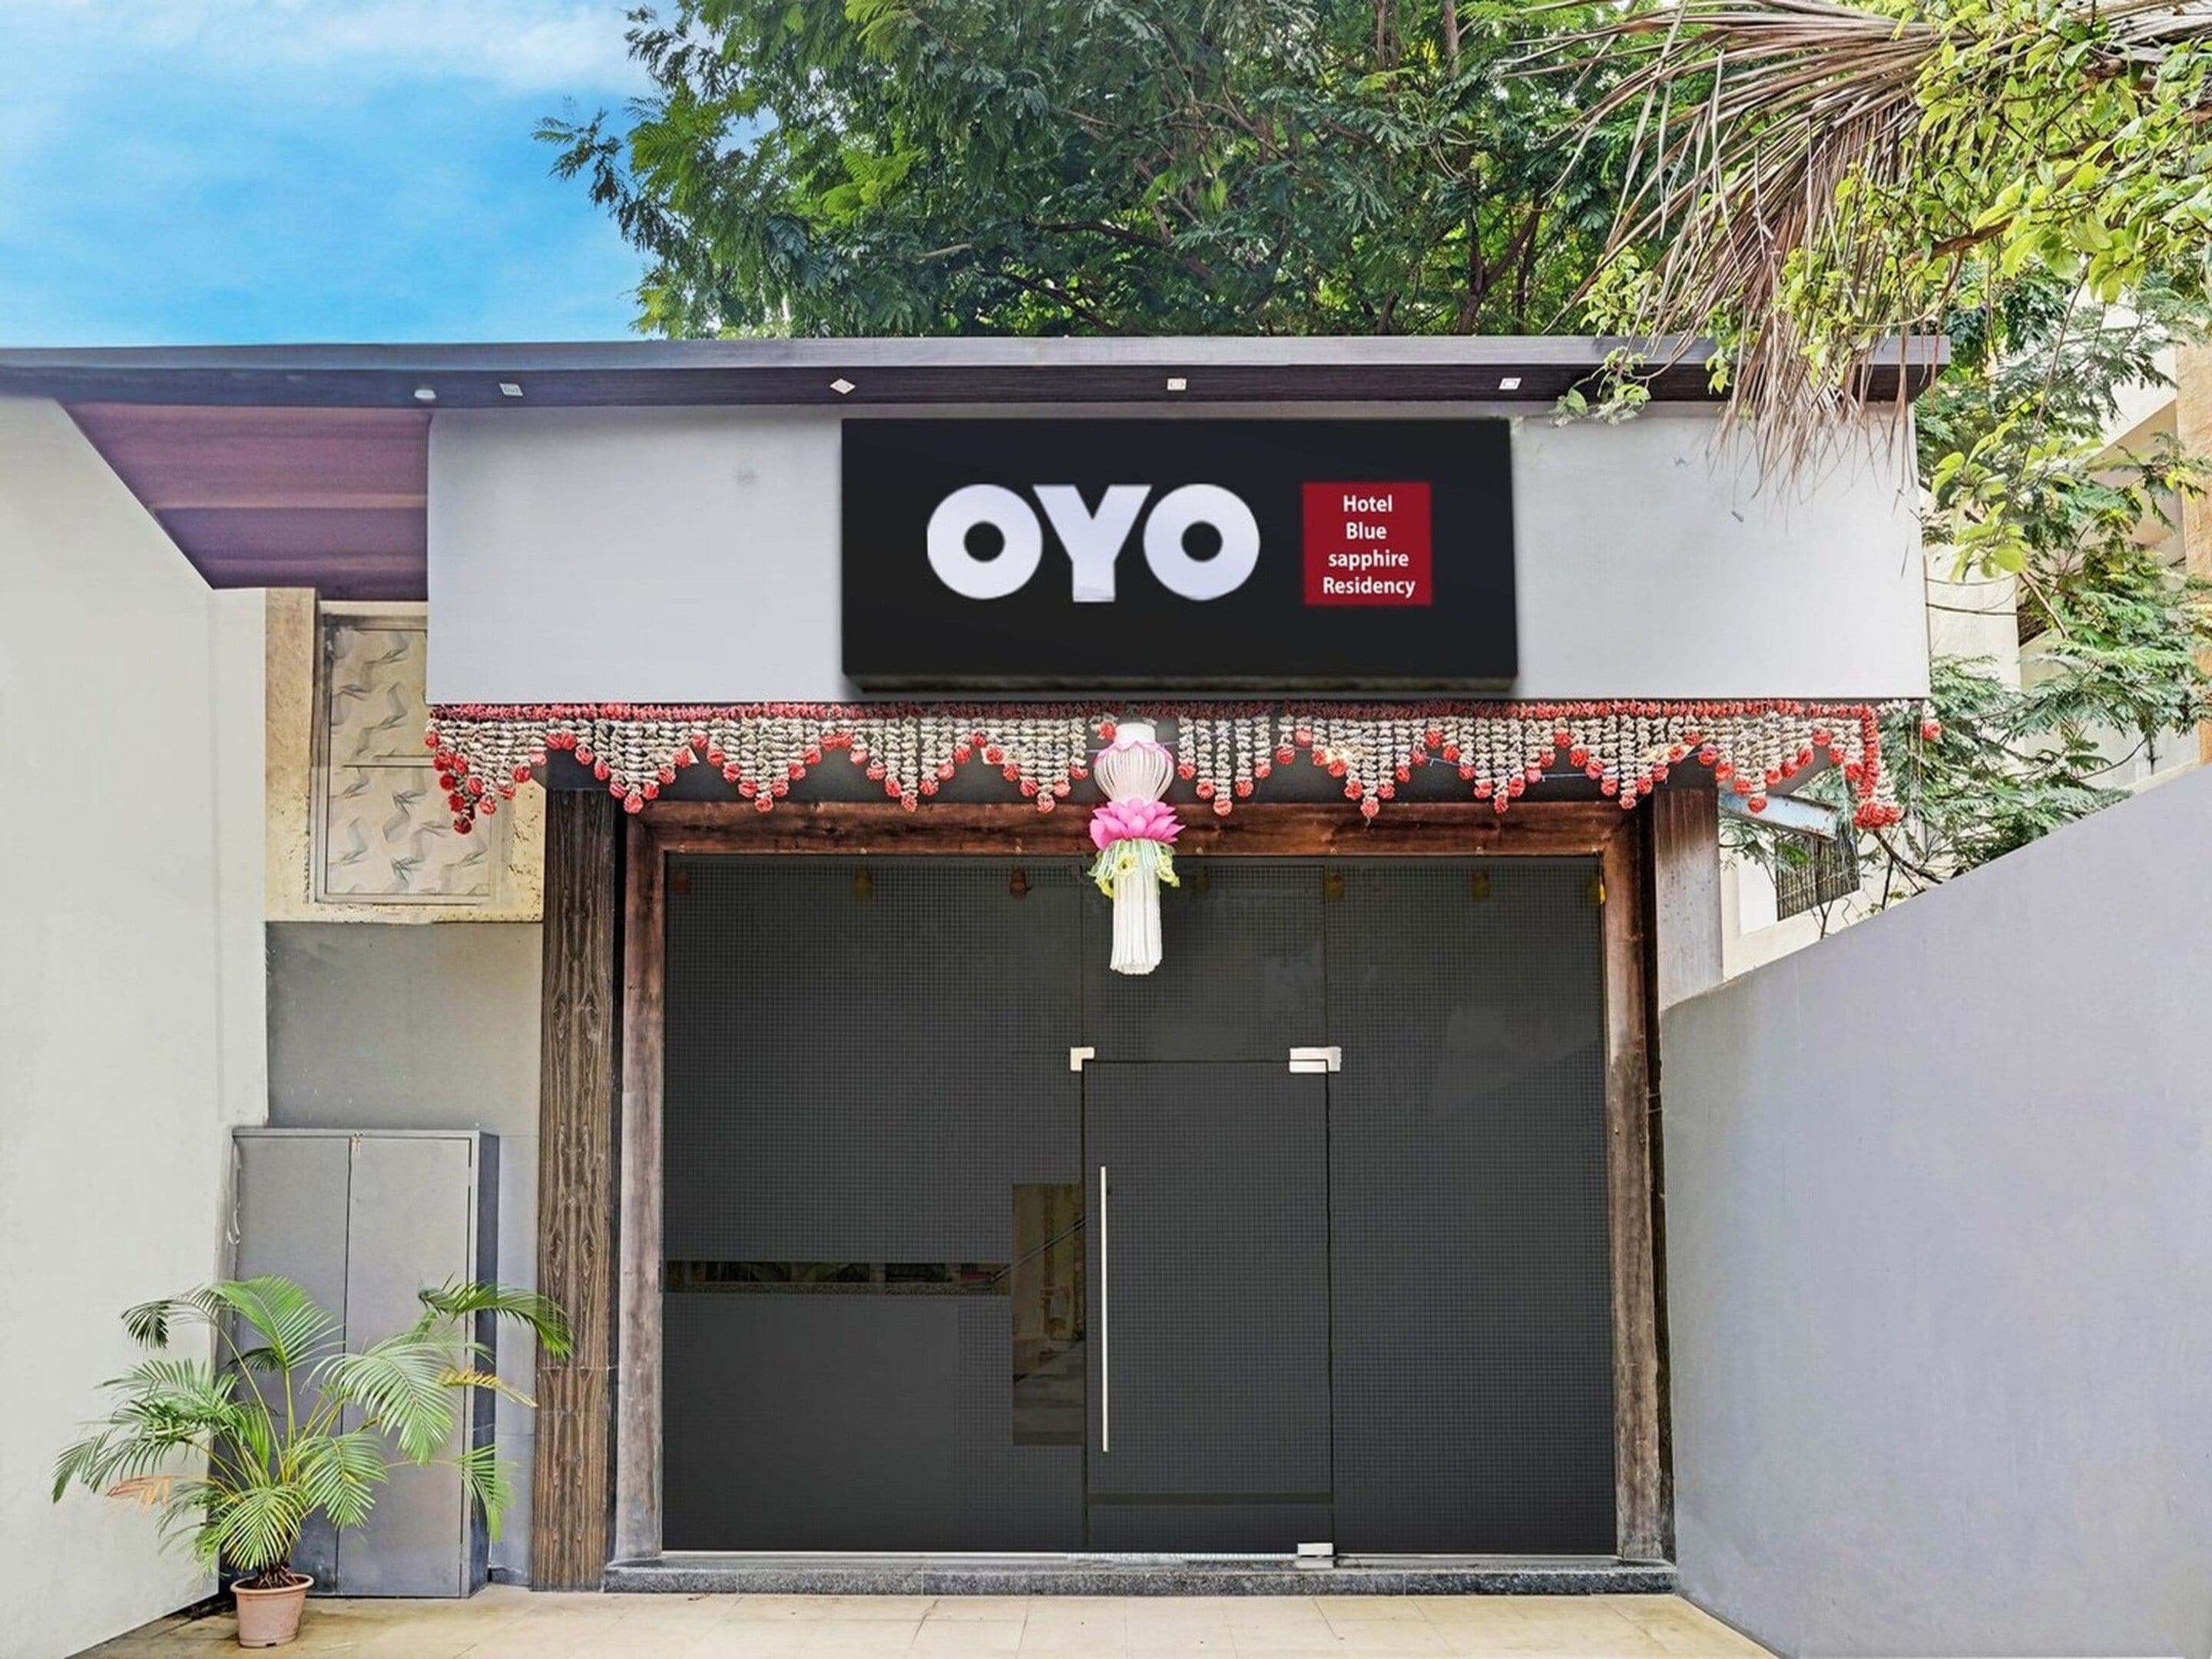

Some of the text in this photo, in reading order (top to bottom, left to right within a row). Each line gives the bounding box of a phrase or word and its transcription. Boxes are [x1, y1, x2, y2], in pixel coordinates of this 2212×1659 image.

[1343, 494, 1393, 512] Hotel
[1346, 522, 1387, 540] Blue
[926, 484, 1260, 603] OYO
[1328, 548, 1409, 571] sapphire
[1323, 576, 1416, 598] Residency
